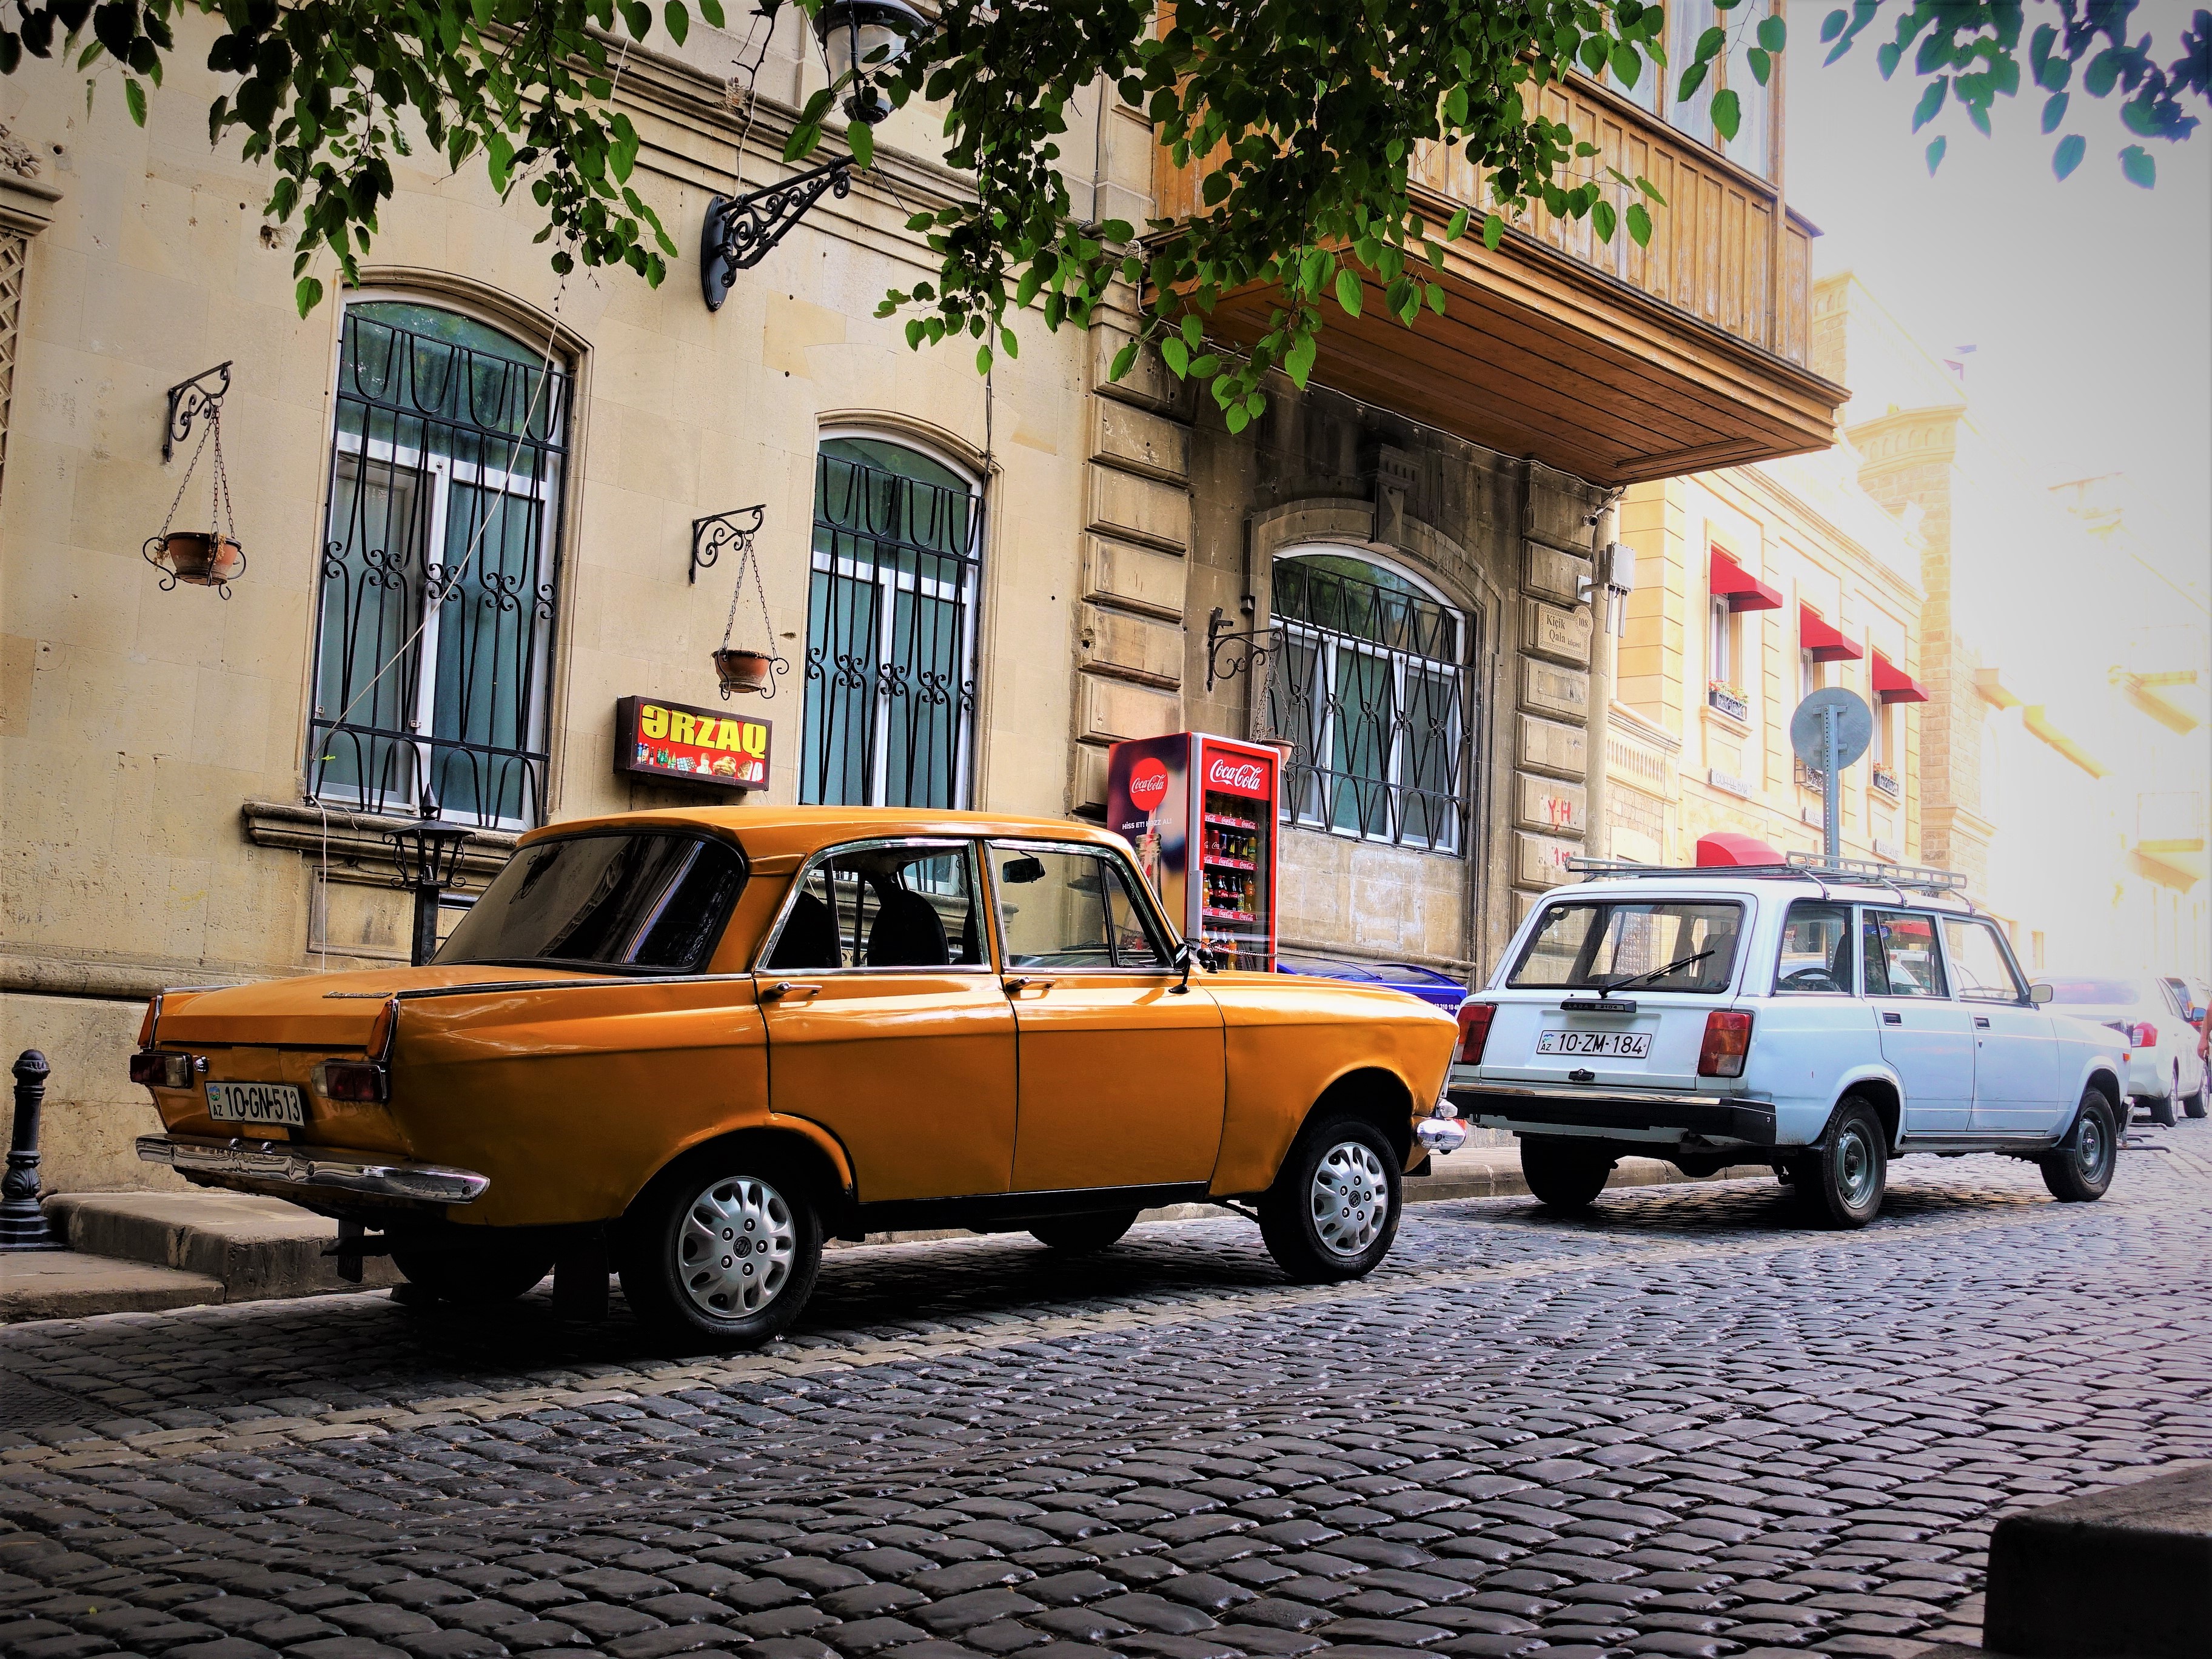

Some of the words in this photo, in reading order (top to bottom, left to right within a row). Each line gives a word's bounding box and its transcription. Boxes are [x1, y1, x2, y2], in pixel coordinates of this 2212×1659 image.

[1547, 614, 1566, 629] Kiçik
[1578, 617, 1588, 629] 108
[1549, 629, 1566, 643] Qala
[642, 704, 767, 760] ƏRZAQ
[1131, 774, 1166, 794] Coca-Cola
[1210, 759, 1264, 791] Coca-Cola
[1715, 773, 1737, 791] COFFEE
[1737, 781, 1748, 794] BAR
[1559, 1033, 1643, 1054] 10-ZM-184
[213, 1105, 223, 1117] AZ
[225, 1086, 300, 1122] 10-GN-513
